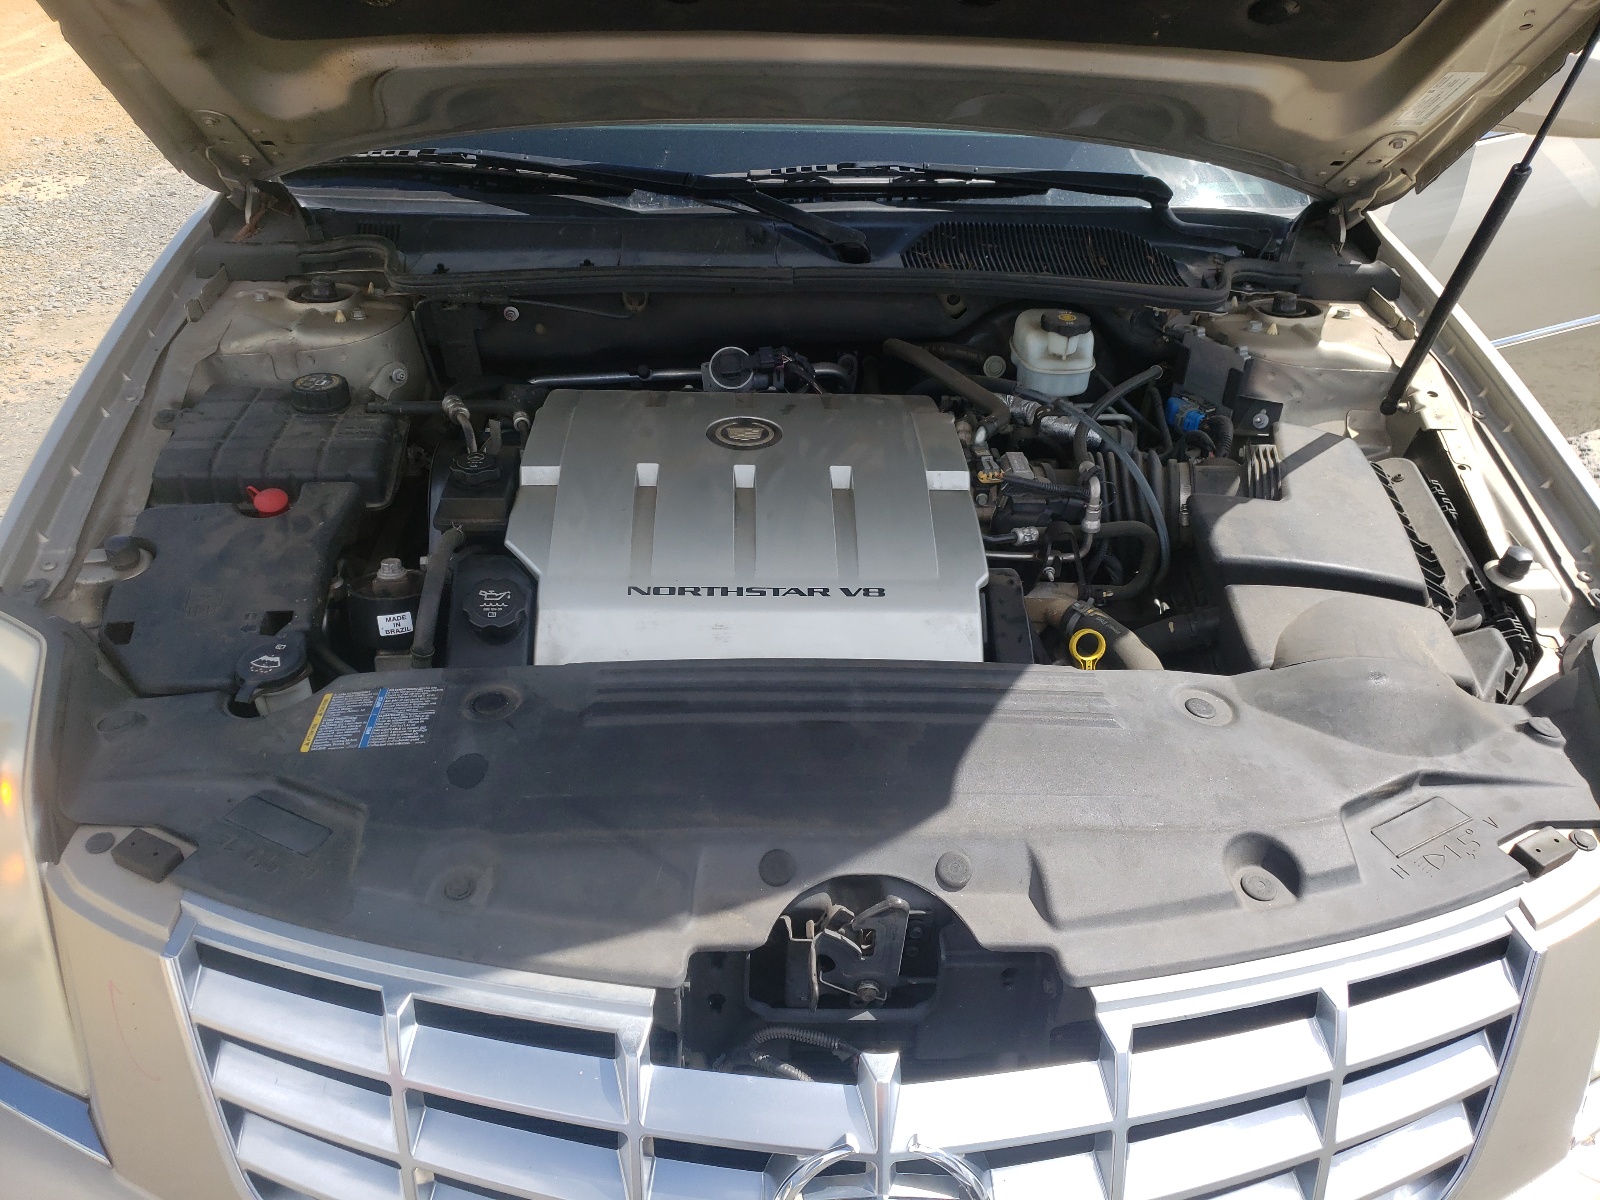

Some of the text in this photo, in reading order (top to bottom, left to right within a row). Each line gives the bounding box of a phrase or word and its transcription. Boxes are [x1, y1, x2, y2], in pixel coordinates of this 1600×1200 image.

[627, 586, 886, 598] NORTHSTAR V8
[385, 615, 407, 623] MADE
[385, 626, 411, 635] BRAZIL
